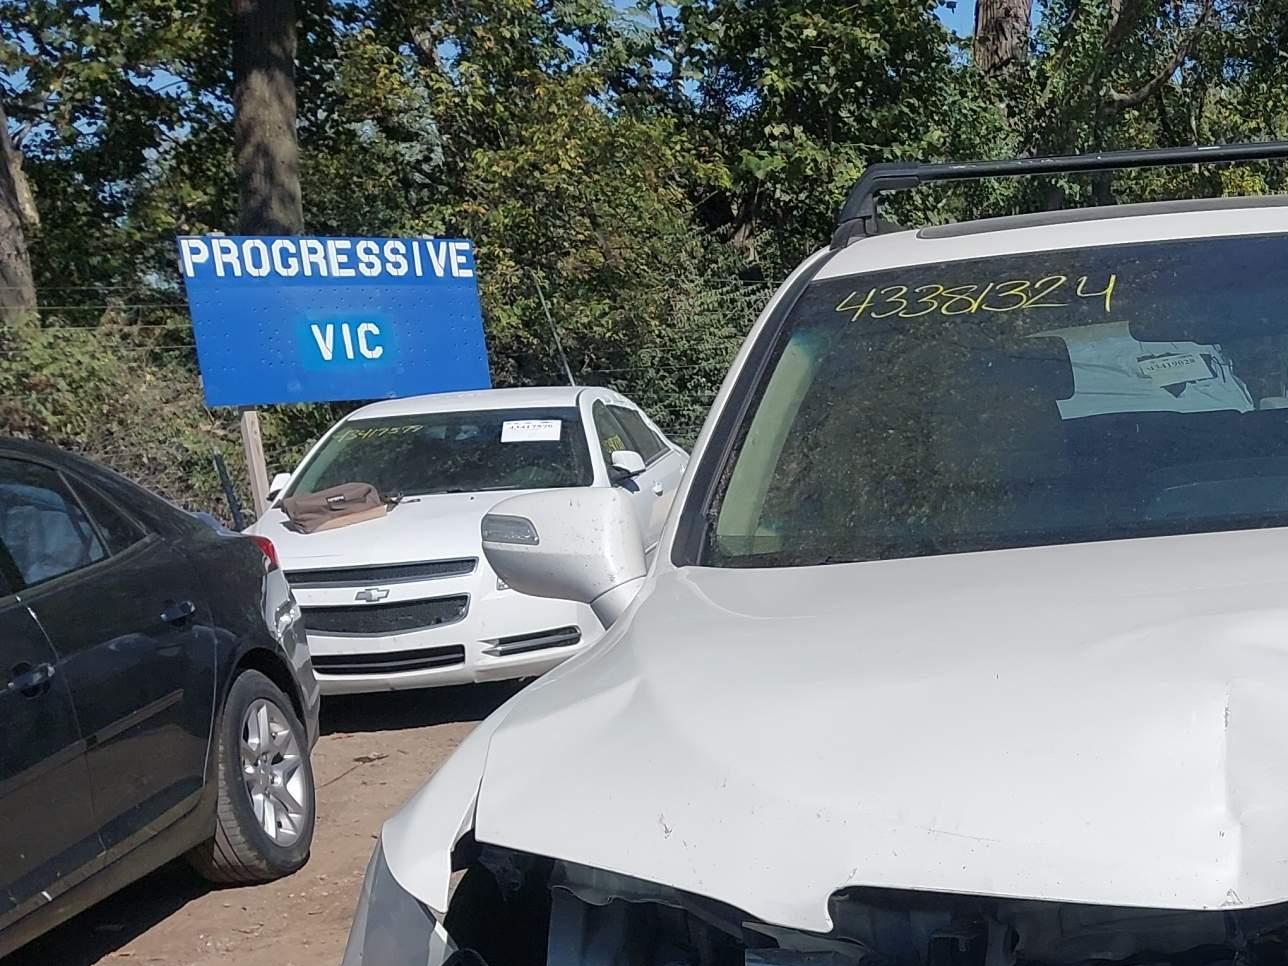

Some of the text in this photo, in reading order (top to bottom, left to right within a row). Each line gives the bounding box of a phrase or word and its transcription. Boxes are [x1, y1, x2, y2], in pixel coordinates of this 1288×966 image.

[179, 239, 474, 278] PROGRESSIVE
[835, 273, 1118, 322] 43381324
[311, 322, 384, 361] VIC
